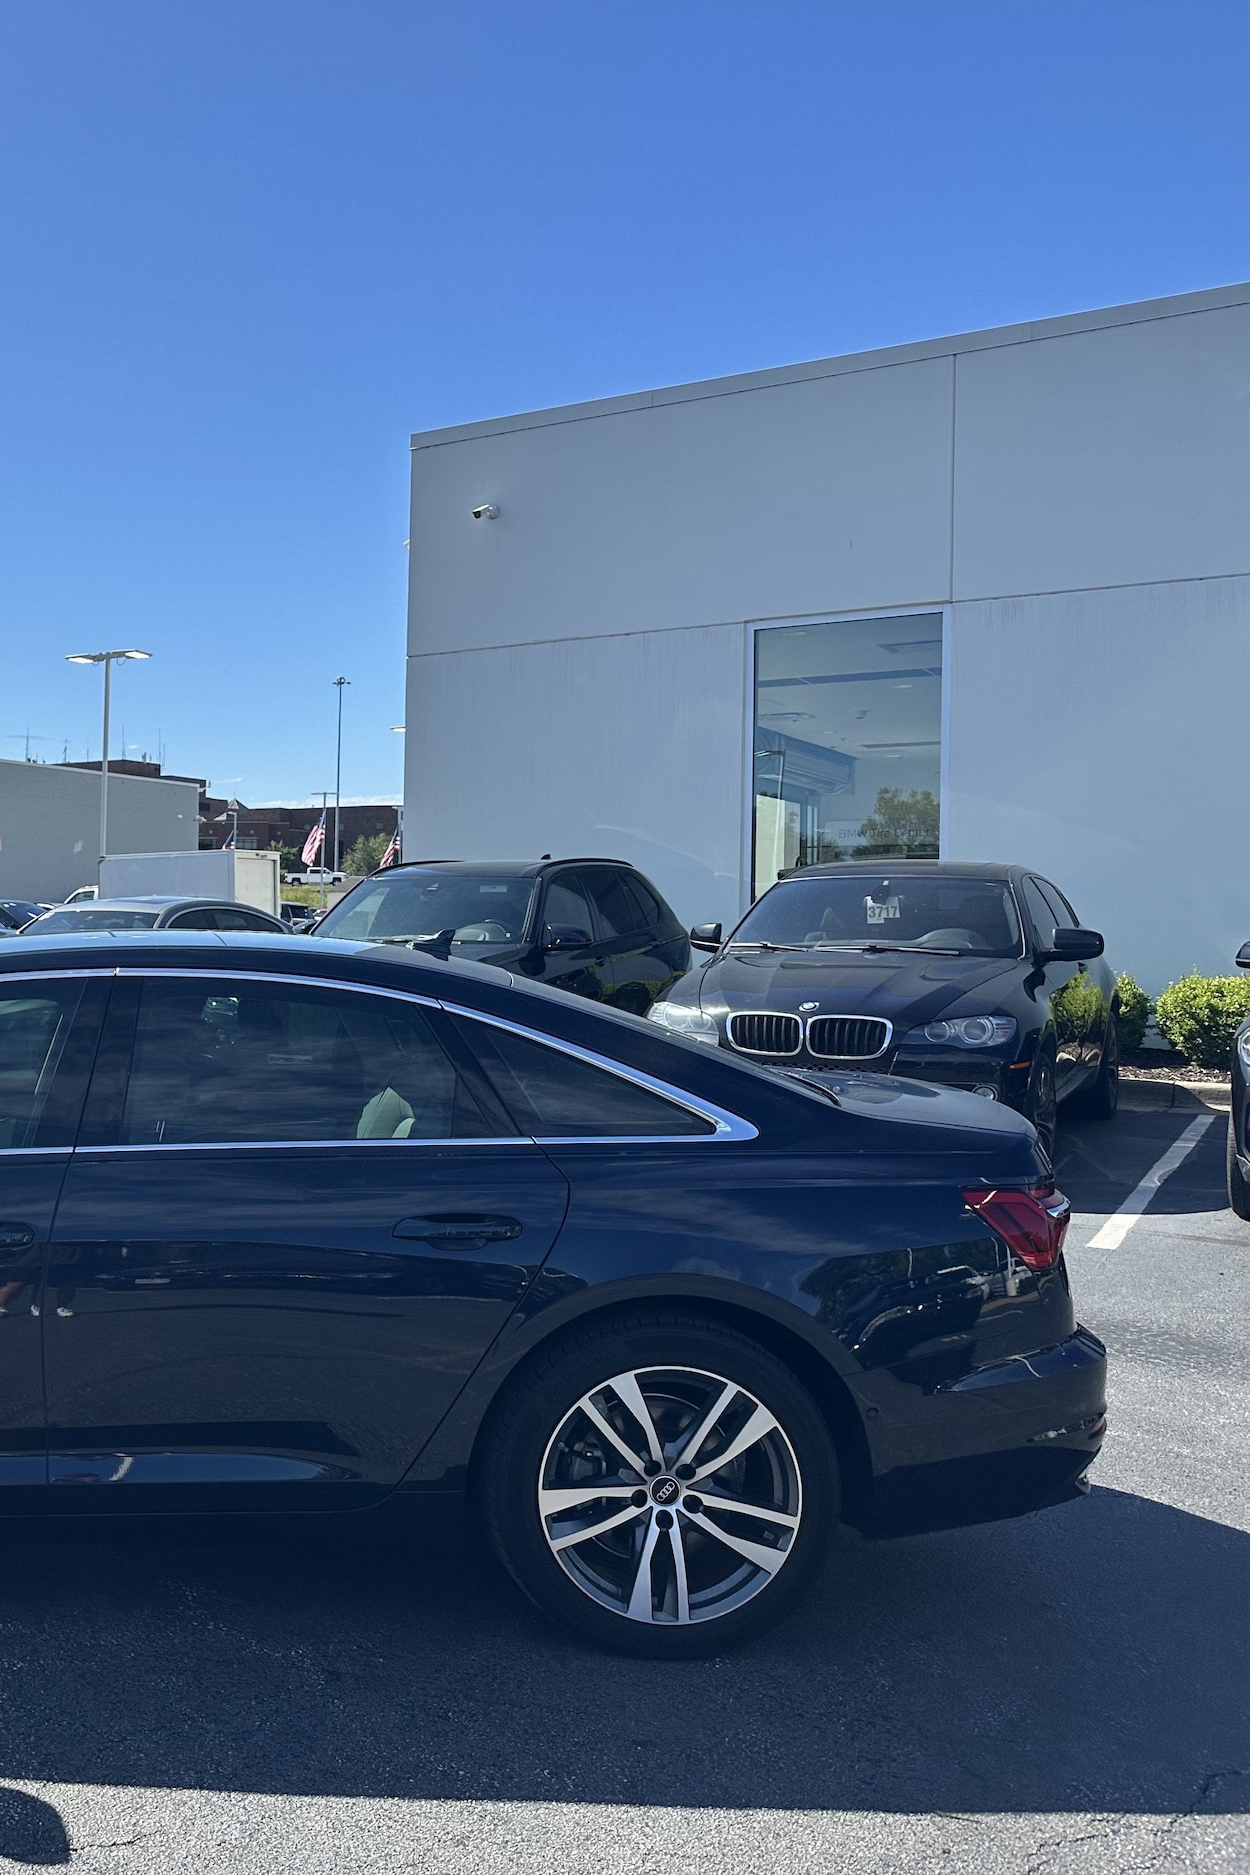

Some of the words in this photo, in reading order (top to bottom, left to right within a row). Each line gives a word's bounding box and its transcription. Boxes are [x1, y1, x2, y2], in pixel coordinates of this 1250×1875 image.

[838, 829, 867, 838] BMW
[870, 828, 890, 838] Tire
[894, 828, 930, 838] Center
[868, 906, 898, 918] 3717
